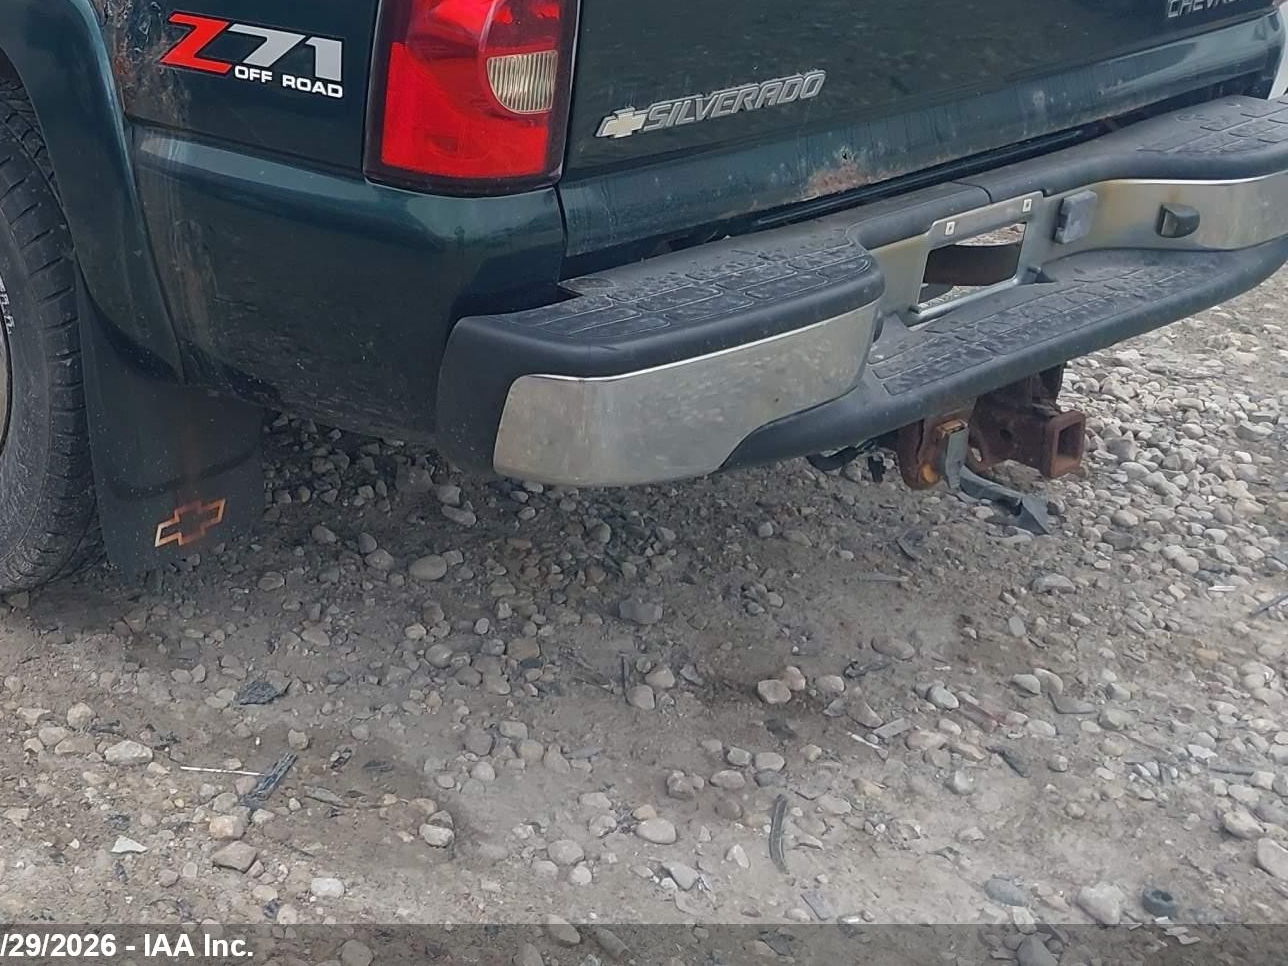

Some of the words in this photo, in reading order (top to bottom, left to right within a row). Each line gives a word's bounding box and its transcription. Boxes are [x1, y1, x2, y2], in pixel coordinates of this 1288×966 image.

[160, 11, 343, 82] Z71
[234, 65, 273, 83] OFF
[282, 74, 344, 98] ROAD
[643, 69, 827, 132] SILVERADO
